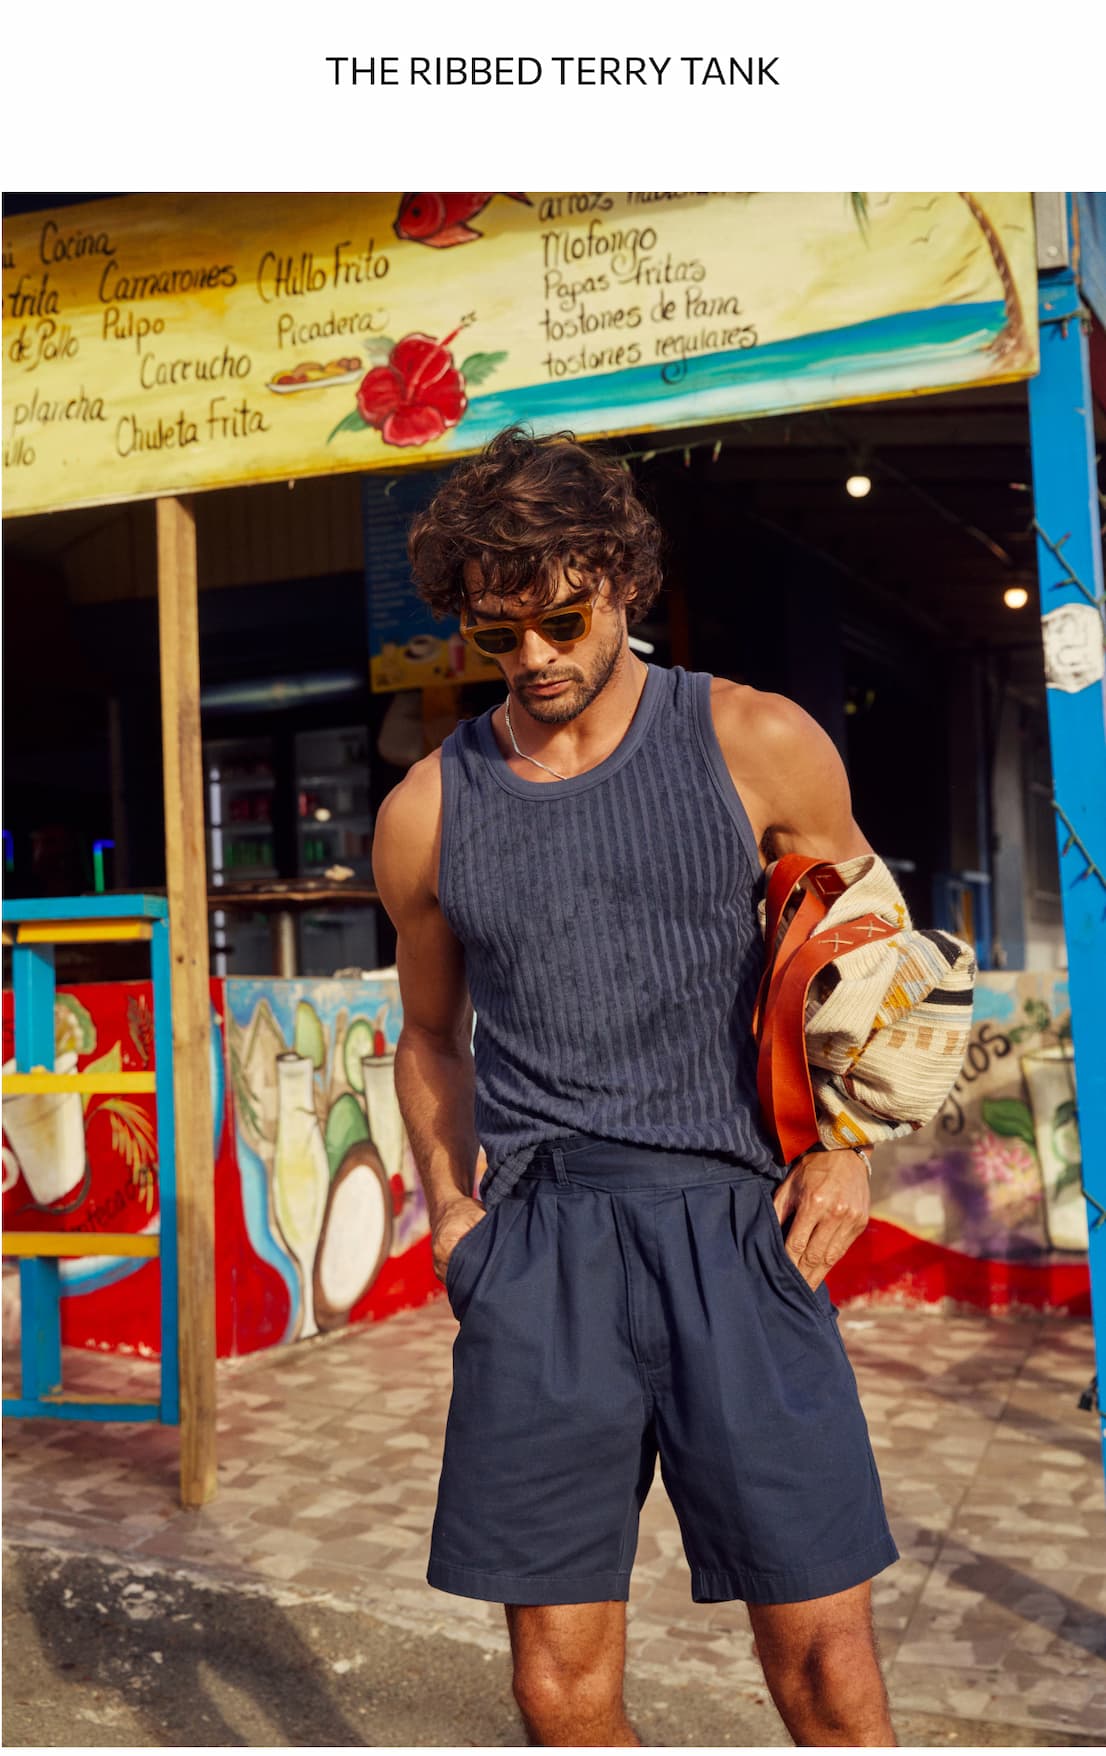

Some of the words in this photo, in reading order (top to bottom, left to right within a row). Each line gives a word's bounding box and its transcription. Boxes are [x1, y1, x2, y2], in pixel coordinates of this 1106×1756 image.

[40, 220, 117, 266] Cocina
[333, 238, 390, 288] Frito
[541, 219, 657, 276] Mofongo
[98, 259, 238, 304] Camarones
[544, 270, 610, 313] Papas
[102, 306, 166, 354] Pulpo
[276, 312, 379, 350] Picadera
[538, 302, 642, 342] tostones
[651, 288, 676, 323] de
[685, 285, 742, 319] Pana
[24, 318, 80, 372] Pollo
[140, 345, 252, 390] Carrucho
[542, 342, 643, 378] tostones
[655, 324, 759, 385] regulares
[12, 384, 108, 437] plancha
[115, 410, 200, 457] Chuleta
